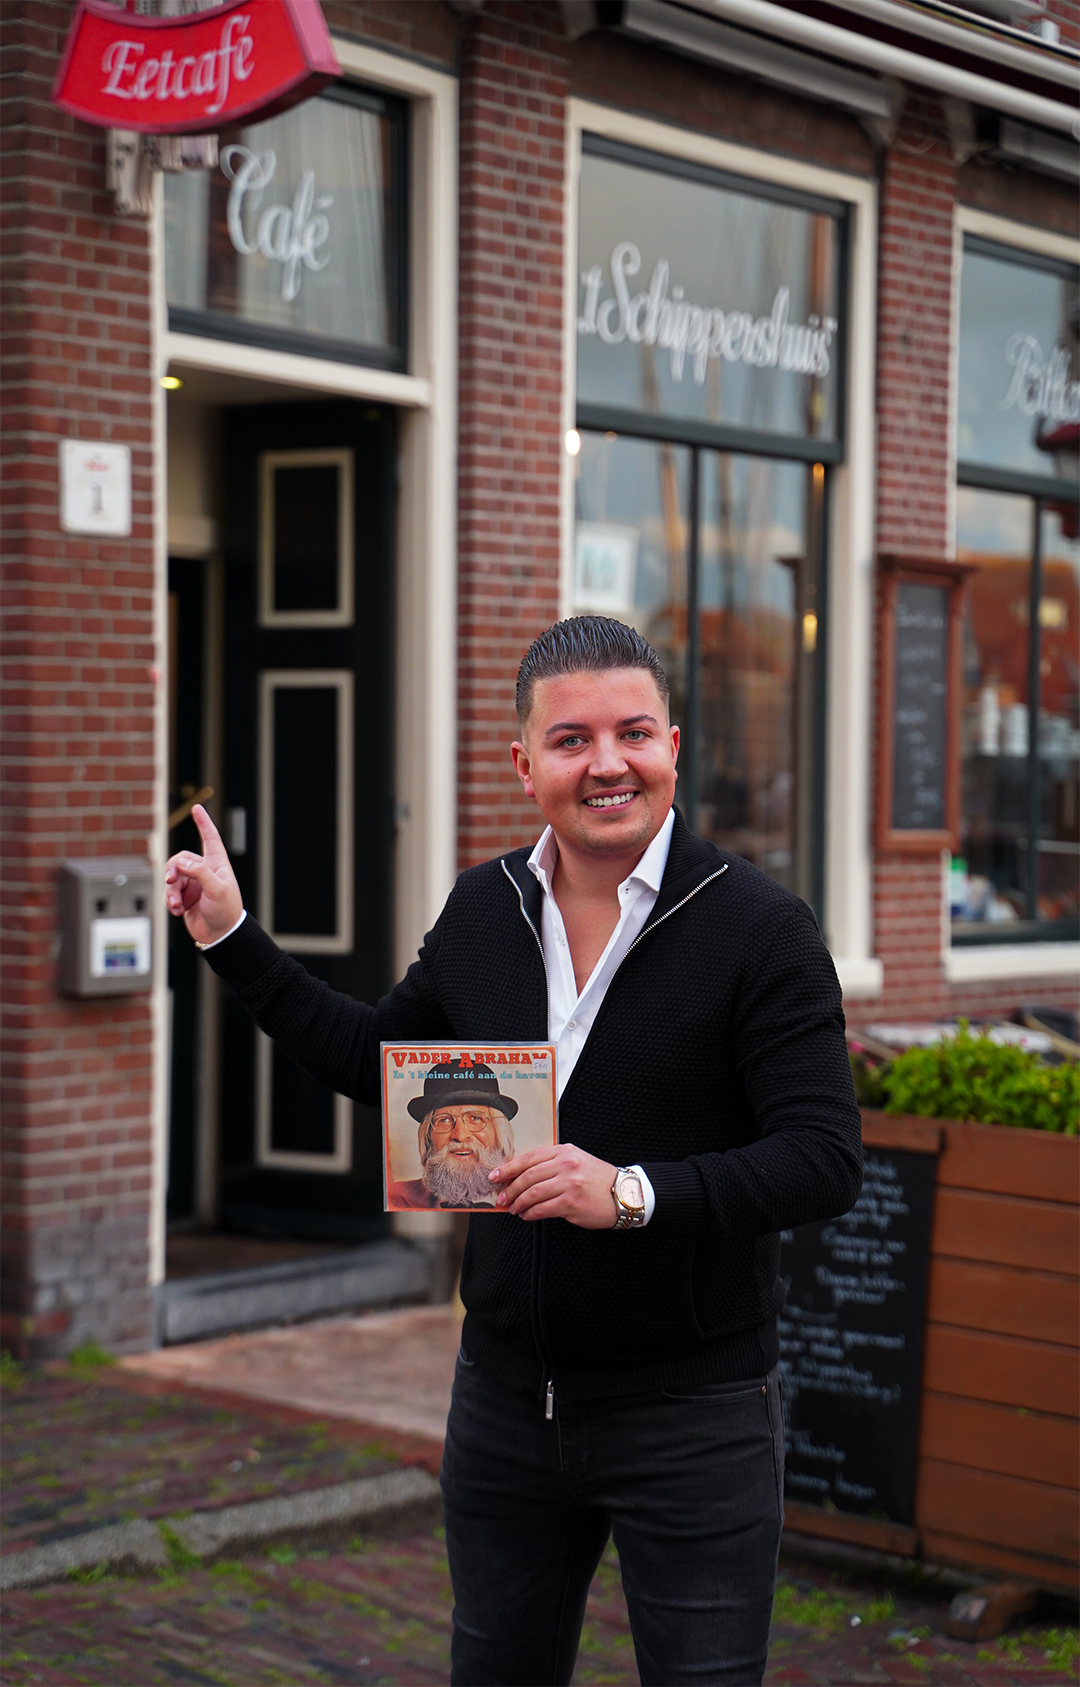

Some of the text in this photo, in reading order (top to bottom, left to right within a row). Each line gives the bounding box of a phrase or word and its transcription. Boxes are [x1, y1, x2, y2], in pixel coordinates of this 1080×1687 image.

[101, 15, 255, 113] Eetcafé
[220, 144, 334, 300] Café
[392, 1052, 452, 1067] VADER
[393, 1070, 405, 1079] In
[418, 1070, 450, 1079] kleine
[453, 1070, 475, 1079] café
[500, 1071, 513, 1080] de
[515, 1071, 548, 1080] haven
